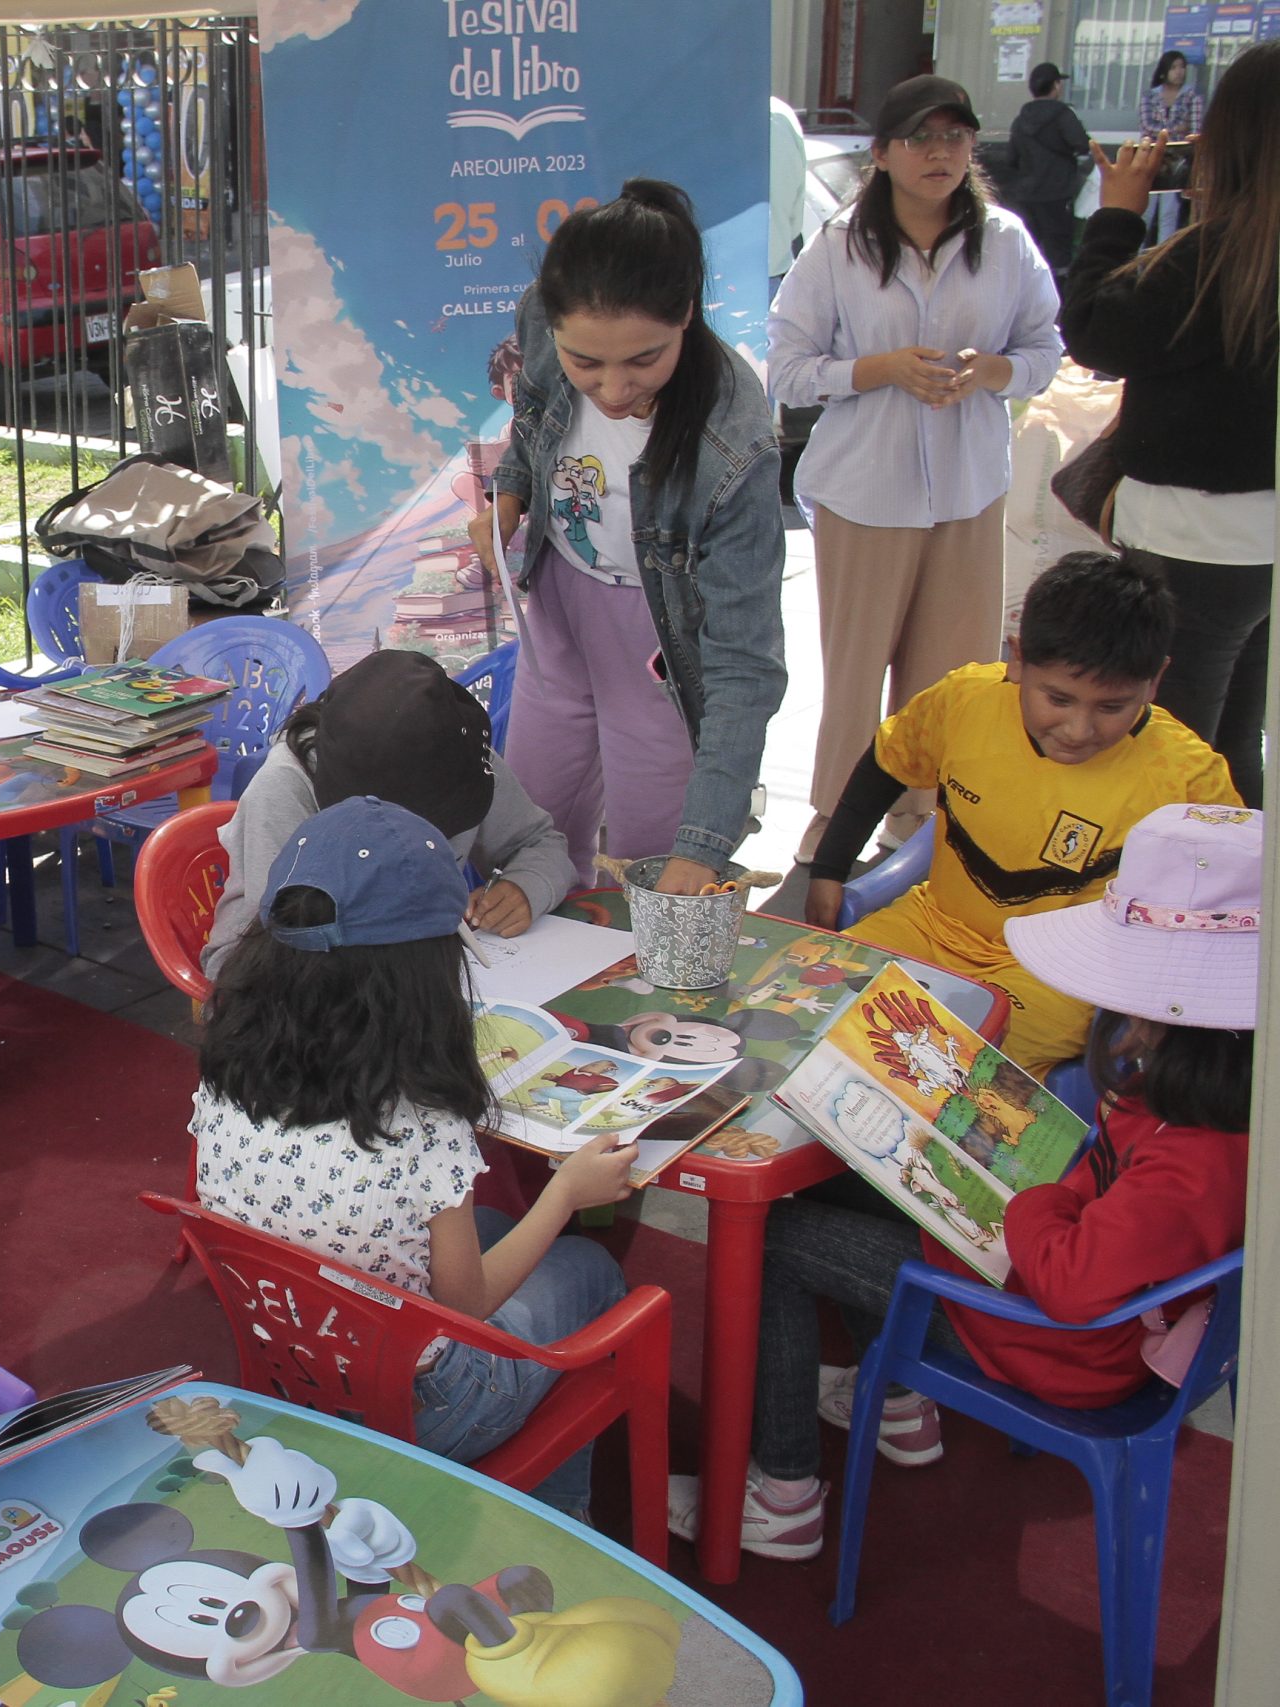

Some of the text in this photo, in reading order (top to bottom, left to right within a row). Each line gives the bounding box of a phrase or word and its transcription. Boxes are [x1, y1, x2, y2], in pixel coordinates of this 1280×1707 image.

[449, 36, 580, 100] del libro
[450, 154, 586, 178] AREQUIPA 2023
[433, 201, 499, 250] 25
[445, 253, 483, 268] Julio
[463, 284, 510, 295] Primera
[442, 302, 493, 317] CALLE
[947, 774, 982, 805] VERCO
